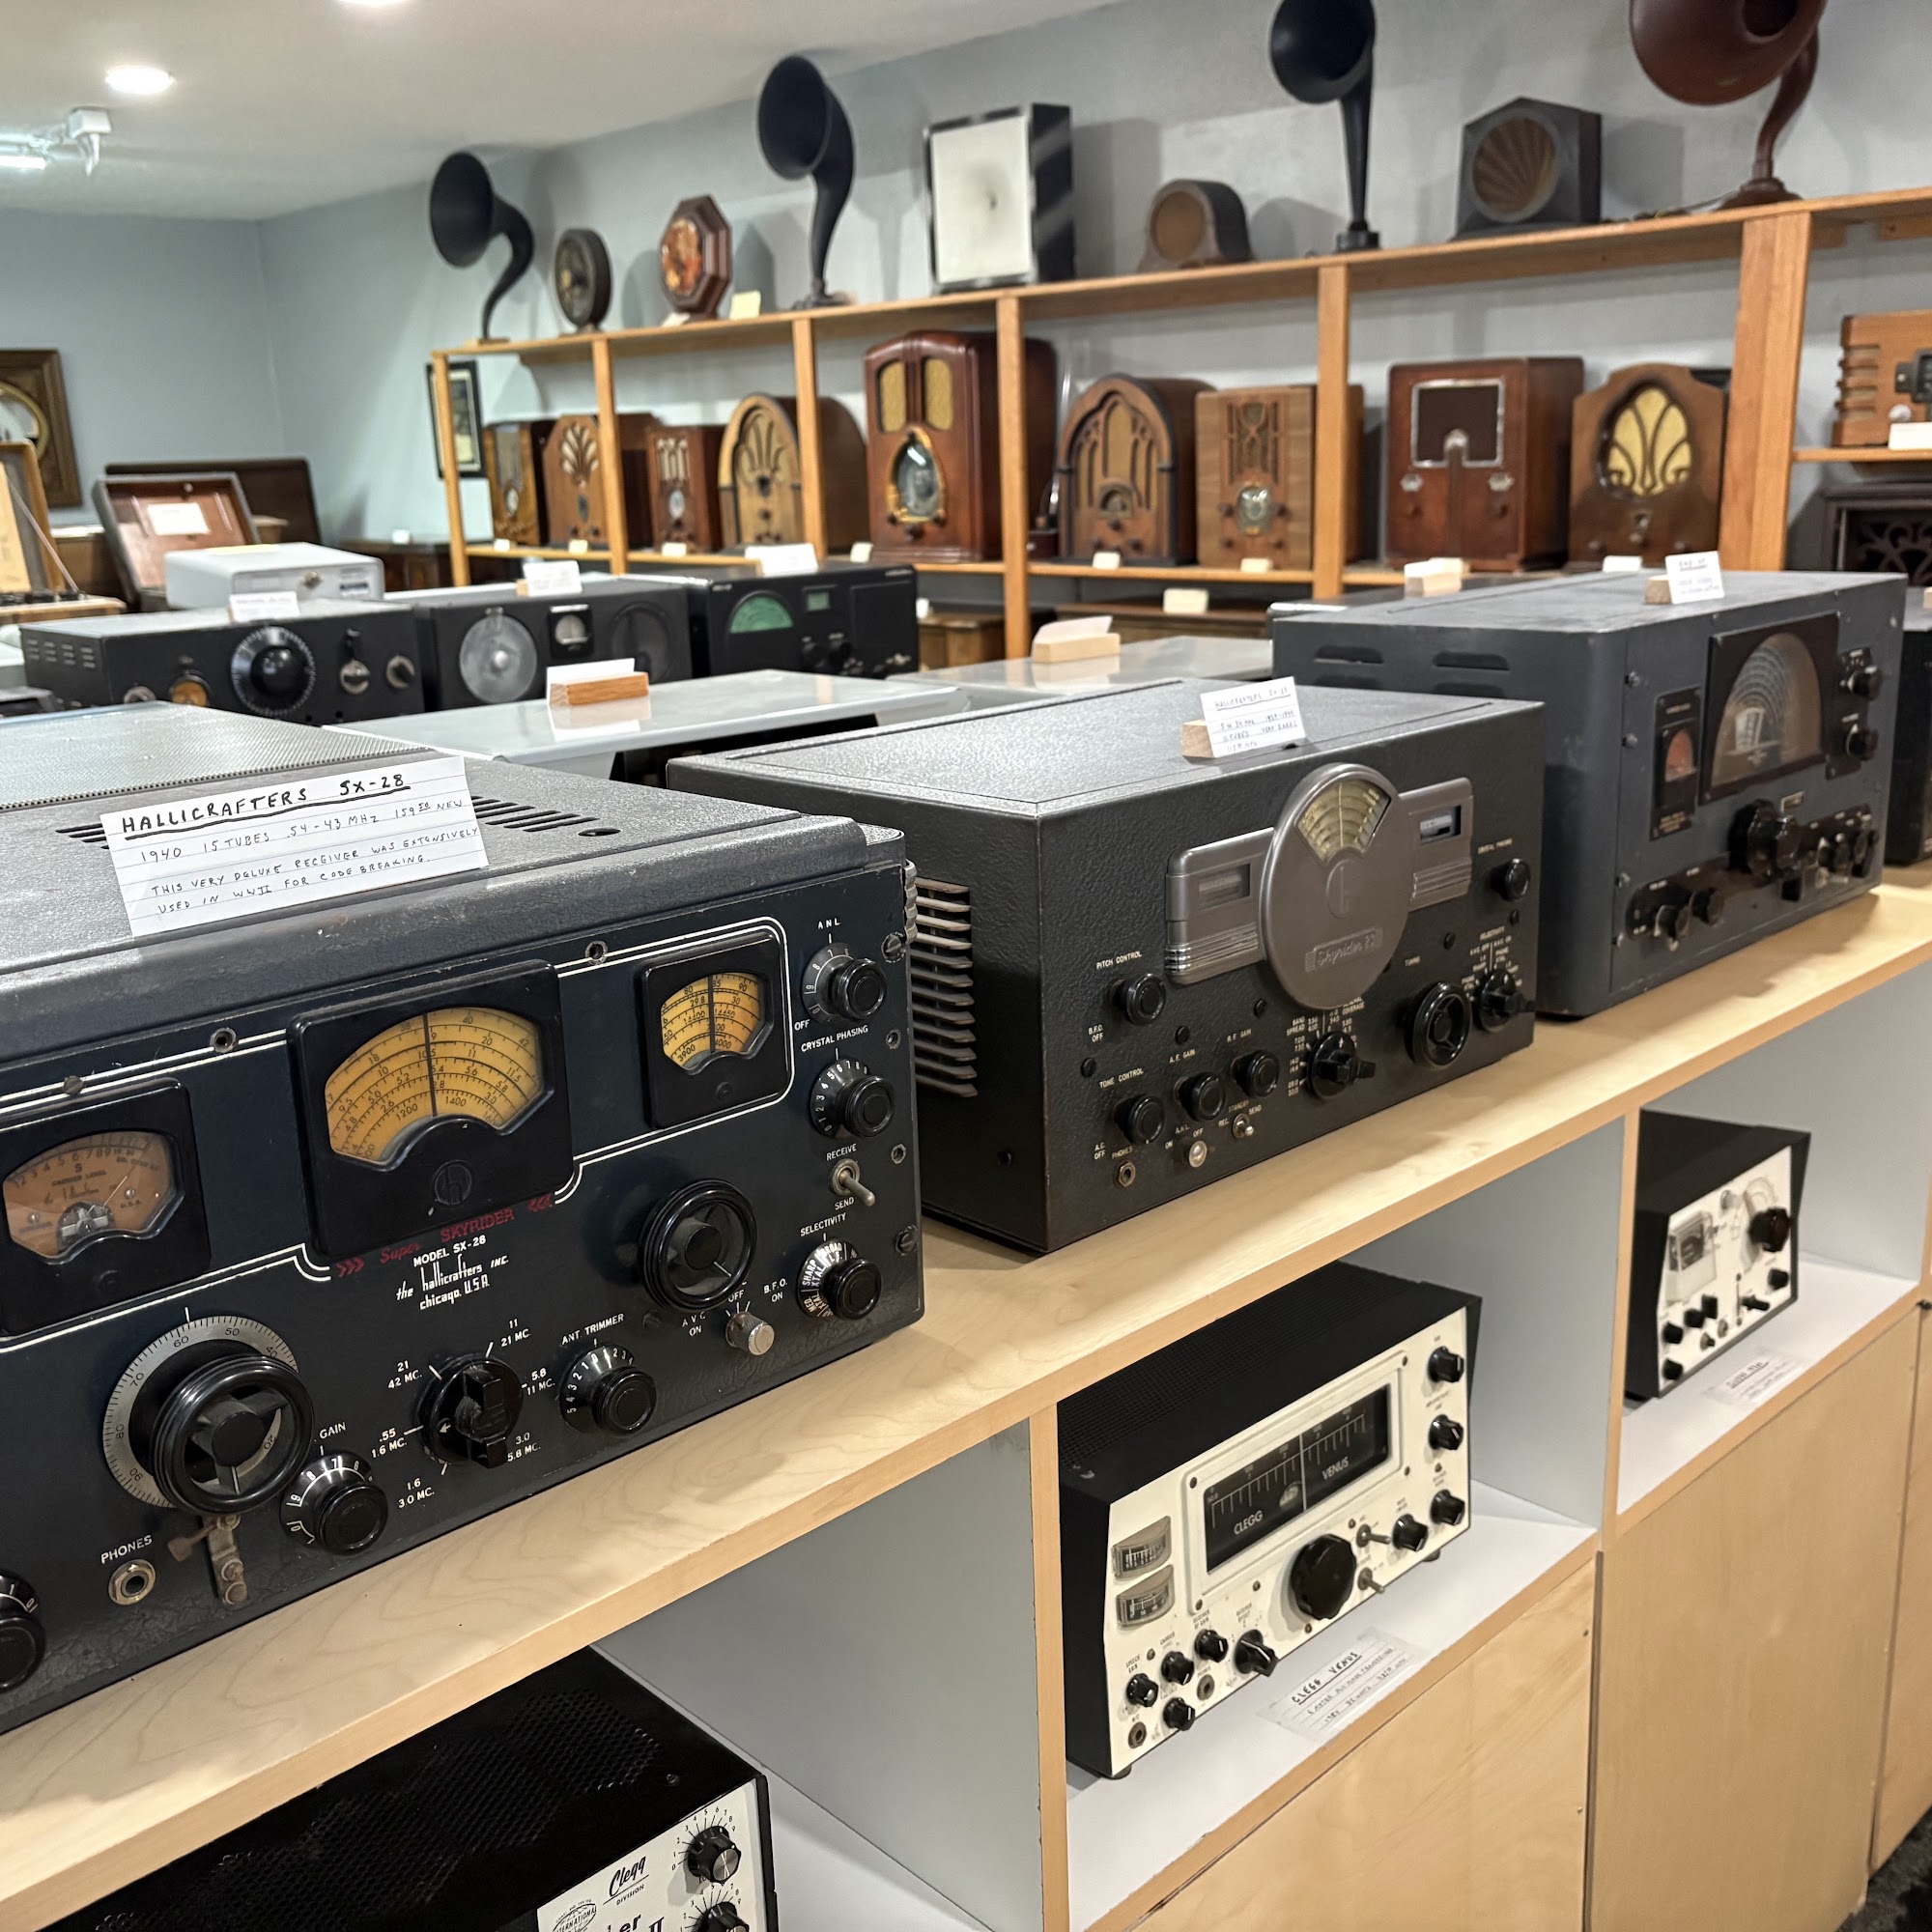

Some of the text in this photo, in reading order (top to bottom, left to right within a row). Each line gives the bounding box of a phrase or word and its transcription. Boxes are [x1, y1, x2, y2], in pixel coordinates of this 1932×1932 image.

[123, 774, 404, 833] HALLICRAFTERS SX-28
[141, 847, 182, 863] 1940
[204, 839, 218, 853] 15
[224, 832, 270, 848] TUBES
[437, 800, 463, 811] NEW
[152, 827, 478, 896] THIS VERY DELUXE RECEIVER WAS EXTENSIVELY
[157, 854, 431, 914] USED IN WWII FOR CODE BREAKING.
[1095, 951, 1143, 970] PITCH CONTROL
[684, 984, 694, 995] 80
[738, 982, 748, 992] 90
[731, 996, 741, 1006] 30
[462, 1015, 474, 1025] 40
[794, 1019, 810, 1031] OFF
[800, 1024, 869, 1053] CRYSTAL PHASING
[1092, 1032, 1104, 1042] OFF
[1239, 1028, 1252, 1038] GAIN
[481, 1036, 494, 1046] 20
[519, 1037, 530, 1048] 42
[368, 1053, 381, 1065] 18
[468, 1049, 477, 1059] 11
[676, 1043, 696, 1063] 3900
[1182, 1048, 1196, 1059] GAIN
[378, 1065, 389, 1077] 10
[826, 1070, 836, 1080] 5
[836, 1064, 843, 1073] 6
[1099, 1067, 1145, 1089] TONE CONTROL
[444, 1095, 467, 1107] 1400
[395, 1102, 418, 1121] 1200
[1192, 1127, 1204, 1138] OFF
[826, 1143, 857, 1161] RECEIVE
[1094, 1150, 1106, 1160] OFF
[1111, 1145, 1133, 1159] PHONES
[834, 1197, 855, 1210] SEND
[800, 1211, 846, 1236] SELECTIVITY
[380, 1208, 515, 1264] Super SKYRIDER
[412, 1235, 487, 1267] MODEL SX-28
[395, 1253, 509, 1301] the hallicrafters INC.
[802, 1259, 817, 1287] SHARP
[810, 1265, 827, 1288] XTAL
[763, 1278, 788, 1294] B.F.O.
[771, 1292, 783, 1302] ON
[508, 1318, 519, 1329] 11
[583, 1313, 625, 1336] TRIMMER
[689, 1324, 702, 1337] ON
[224, 1327, 241, 1337] 50
[500, 1328, 531, 1348] 21 MC.
[173, 1335, 189, 1349] 60
[397, 1360, 410, 1373] 21
[129, 1372, 145, 1388] 70
[387, 1370, 423, 1390] 42 MC.
[531, 1368, 547, 1381] 5.8
[573, 1372, 582, 1380] 2
[526, 1378, 556, 1396] 11 MC.
[115, 1424, 125, 1439] 80
[319, 1421, 347, 1439] GAIN
[378, 1428, 396, 1443] .55
[515, 1433, 530, 1445] 3.0
[371, 1436, 408, 1459] 1.6 MC.
[507, 1441, 542, 1462] 5.8 MC.
[128, 1467, 143, 1482] 90
[1321, 1456, 1350, 1481] VENUS
[407, 1477, 421, 1491] 1.6
[398, 1486, 436, 1509] 3.0 MC.
[1233, 1509, 1264, 1535] CLEGG
[100, 1534, 153, 1564] PHONES
[1291, 1651, 1358, 1703] CLEGG VENUS
[609, 1856, 646, 1897] Clegg
[615, 1884, 644, 1905] DIVISION
